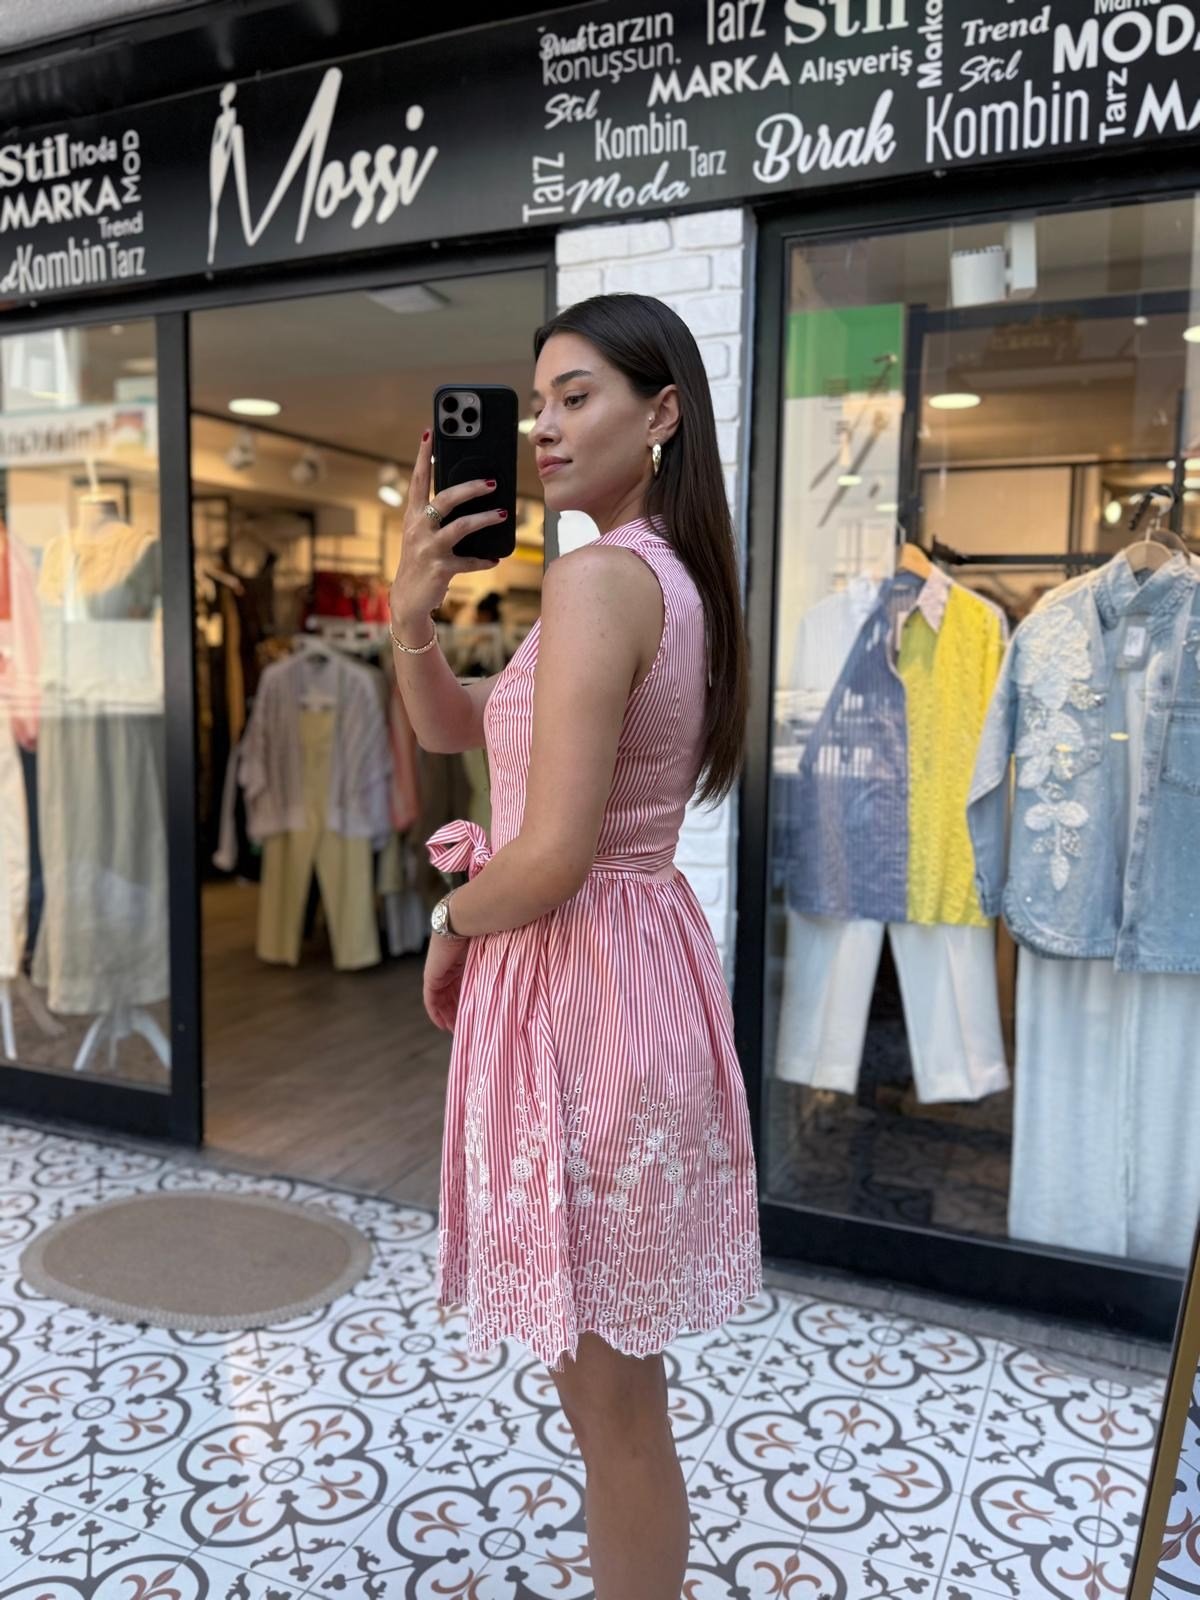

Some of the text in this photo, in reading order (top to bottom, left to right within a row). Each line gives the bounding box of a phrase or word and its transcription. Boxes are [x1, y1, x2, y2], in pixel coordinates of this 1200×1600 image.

[587, 12, 674, 50] tarzın
[961, 5, 1051, 47] Trend
[1052, 4, 1200, 74] MOD
[543, 42, 682, 86] konuşsun.
[647, 51, 791, 107] MARKA
[798, 45, 913, 86] Alışveriş
[925, 79, 1089, 163] Kombin
[1098, 67, 1128, 144] Tarz
[1133, 78, 1200, 139] M
[0, 133, 71, 188] Stil
[69, 136, 118, 169] Moda
[595, 112, 687, 162] Kombin
[687, 146, 726, 178] Tarz
[752, 88, 897, 184] Bırak
[208, 67, 439, 264] Mossi
[522, 152, 565, 223] Tarz
[565, 160, 691, 215] Moda
[0, 174, 123, 234] MARKA
[98, 210, 144, 239] Trend
[16, 236, 107, 294] Kombin
[107, 241, 147, 279] Tarz
